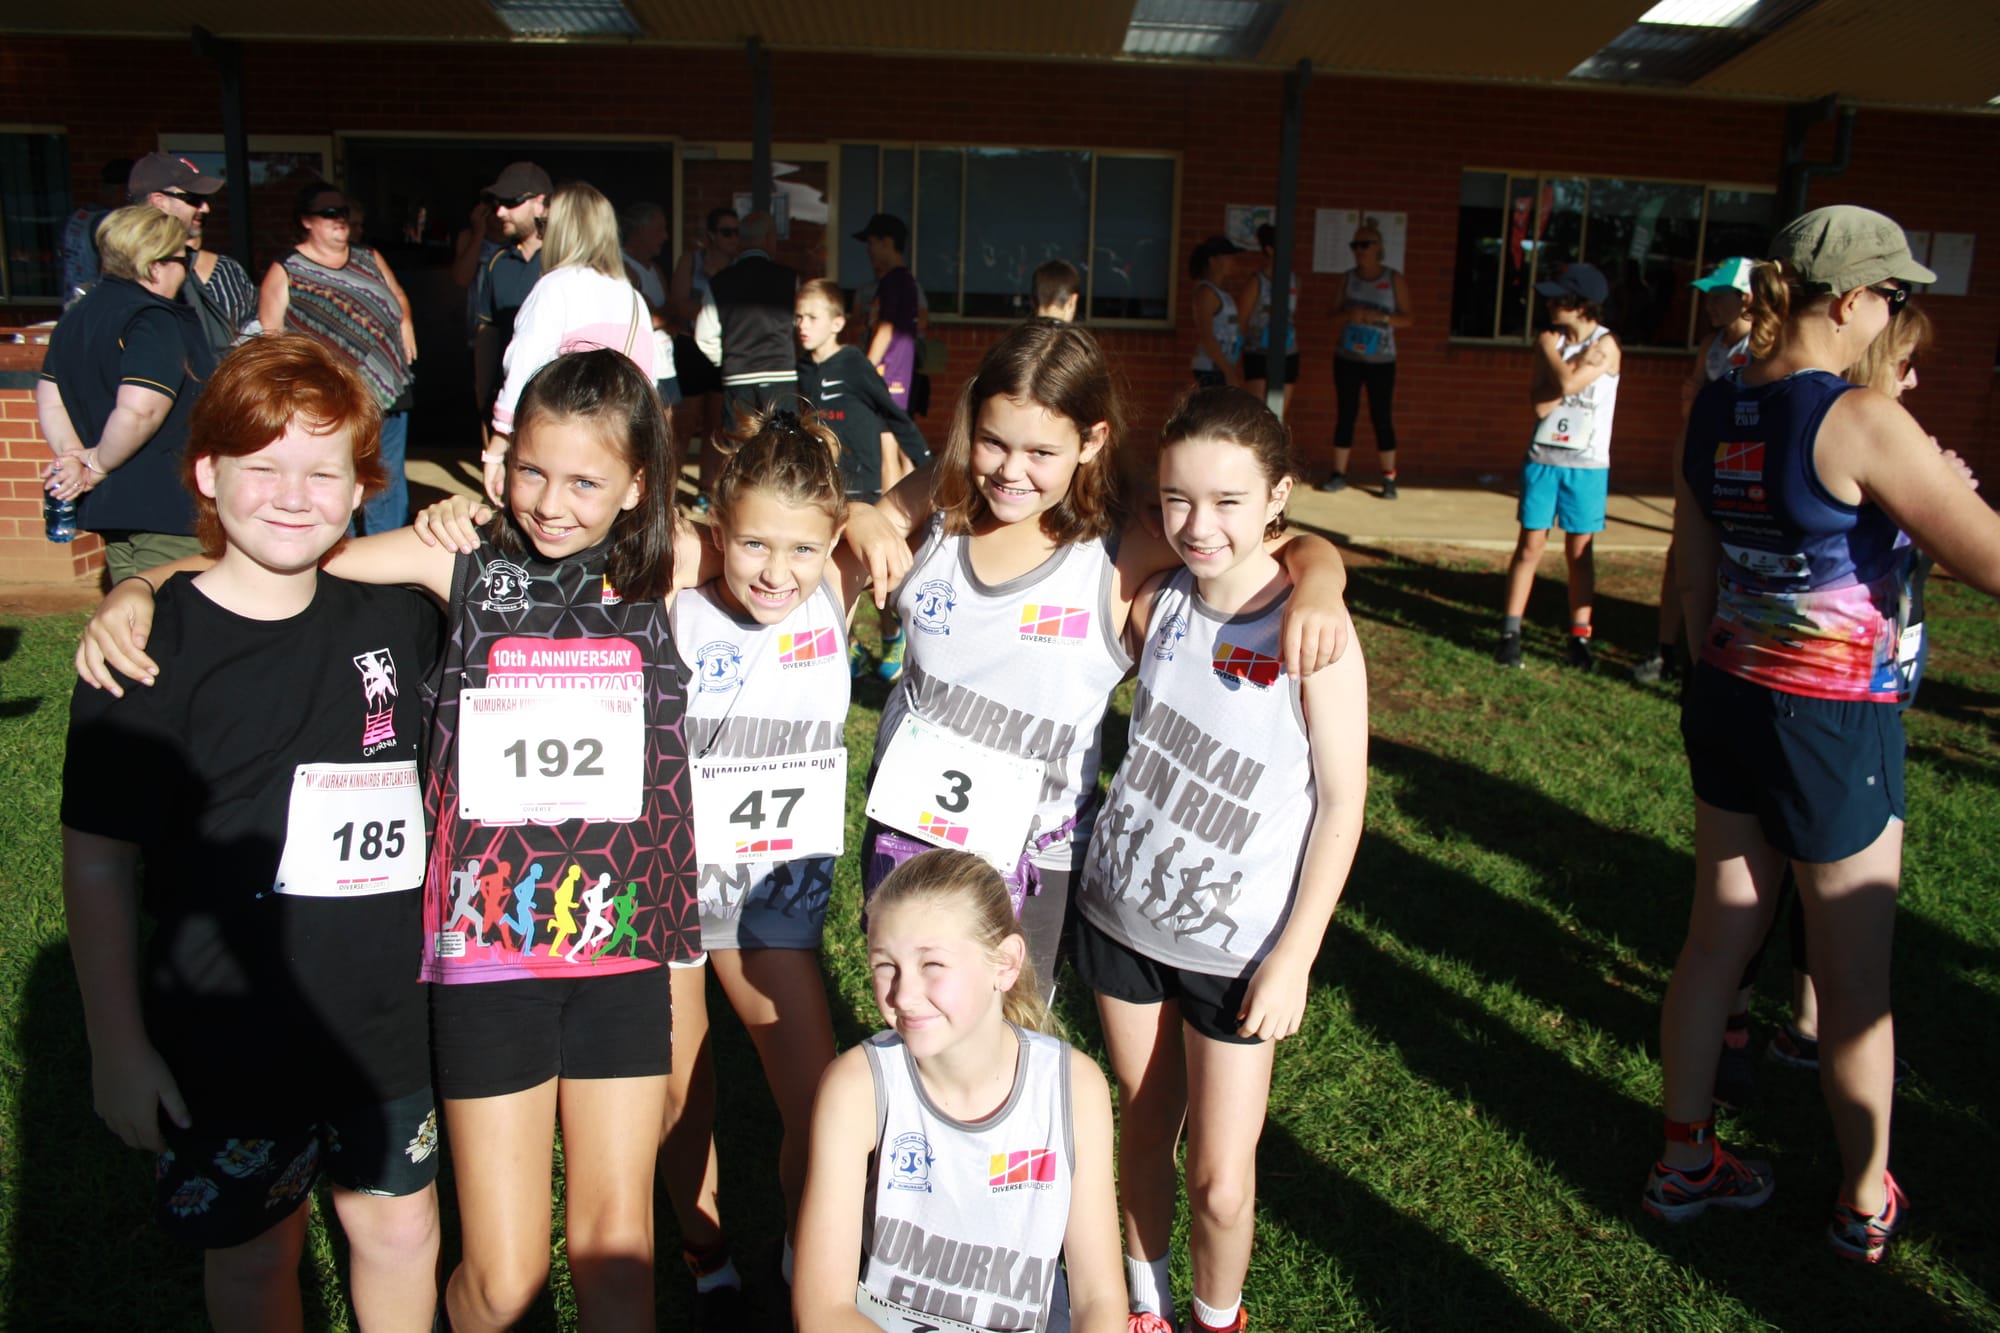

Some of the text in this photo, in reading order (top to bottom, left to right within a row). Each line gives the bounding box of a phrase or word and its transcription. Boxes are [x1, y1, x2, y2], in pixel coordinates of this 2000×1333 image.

[1558, 418, 1568, 433] 6
[493, 649, 632, 667] 10th ANNIVERSARY
[617, 699, 632, 714] RUN
[504, 738, 604, 777] 192
[729, 788, 805, 830] 47
[935, 769, 973, 814] 3
[1168, 779, 1262, 855] RUN
[332, 819, 406, 862] 185
